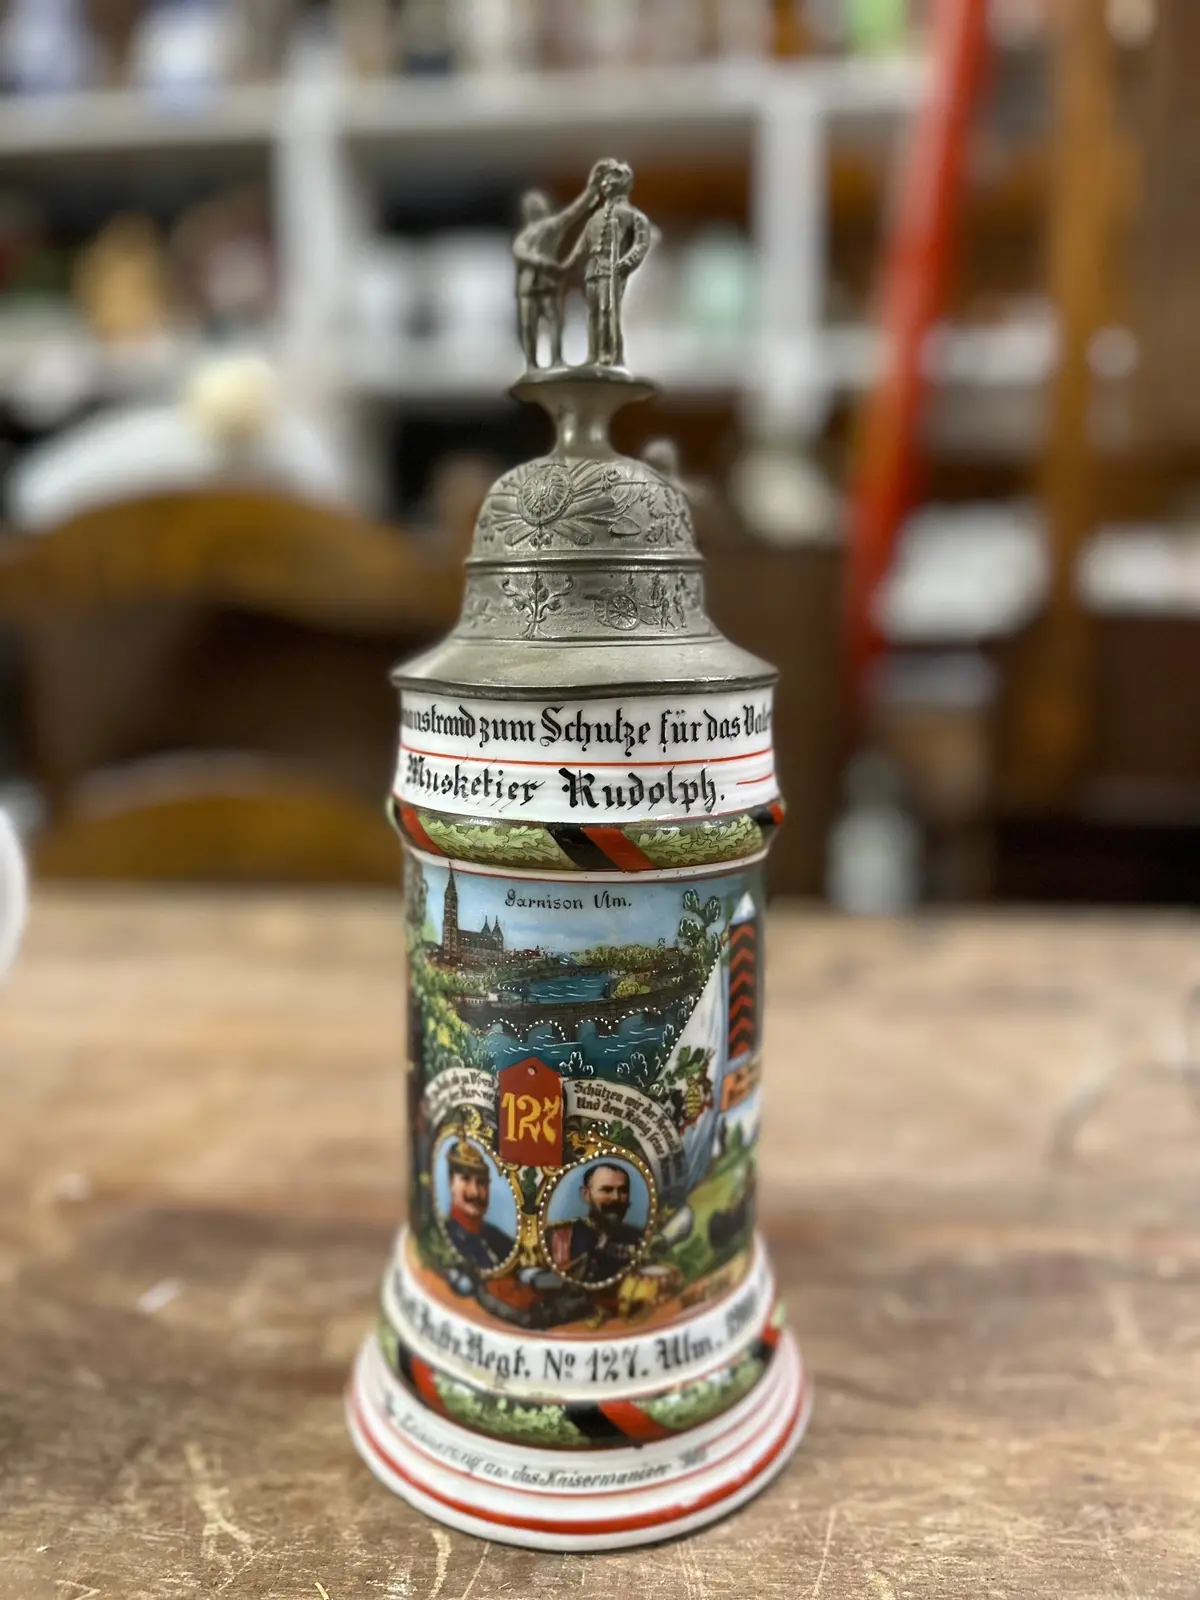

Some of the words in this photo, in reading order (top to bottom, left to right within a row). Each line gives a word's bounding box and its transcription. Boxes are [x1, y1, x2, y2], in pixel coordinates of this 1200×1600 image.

[479, 716, 536, 748] zum
[540, 706, 652, 757] Schutze
[659, 709, 702, 753] für
[703, 709, 741, 741] das
[405, 753, 546, 808] Musketier
[558, 766, 725, 813] Rudolph.
[505, 889, 584, 909] Garnison
[594, 890, 632, 909] Ulm.
[574, 1081, 624, 1104] Schützen
[624, 1096, 645, 1111] wir
[602, 1100, 625, 1117] dem
[585, 1343, 650, 1382] 127.
